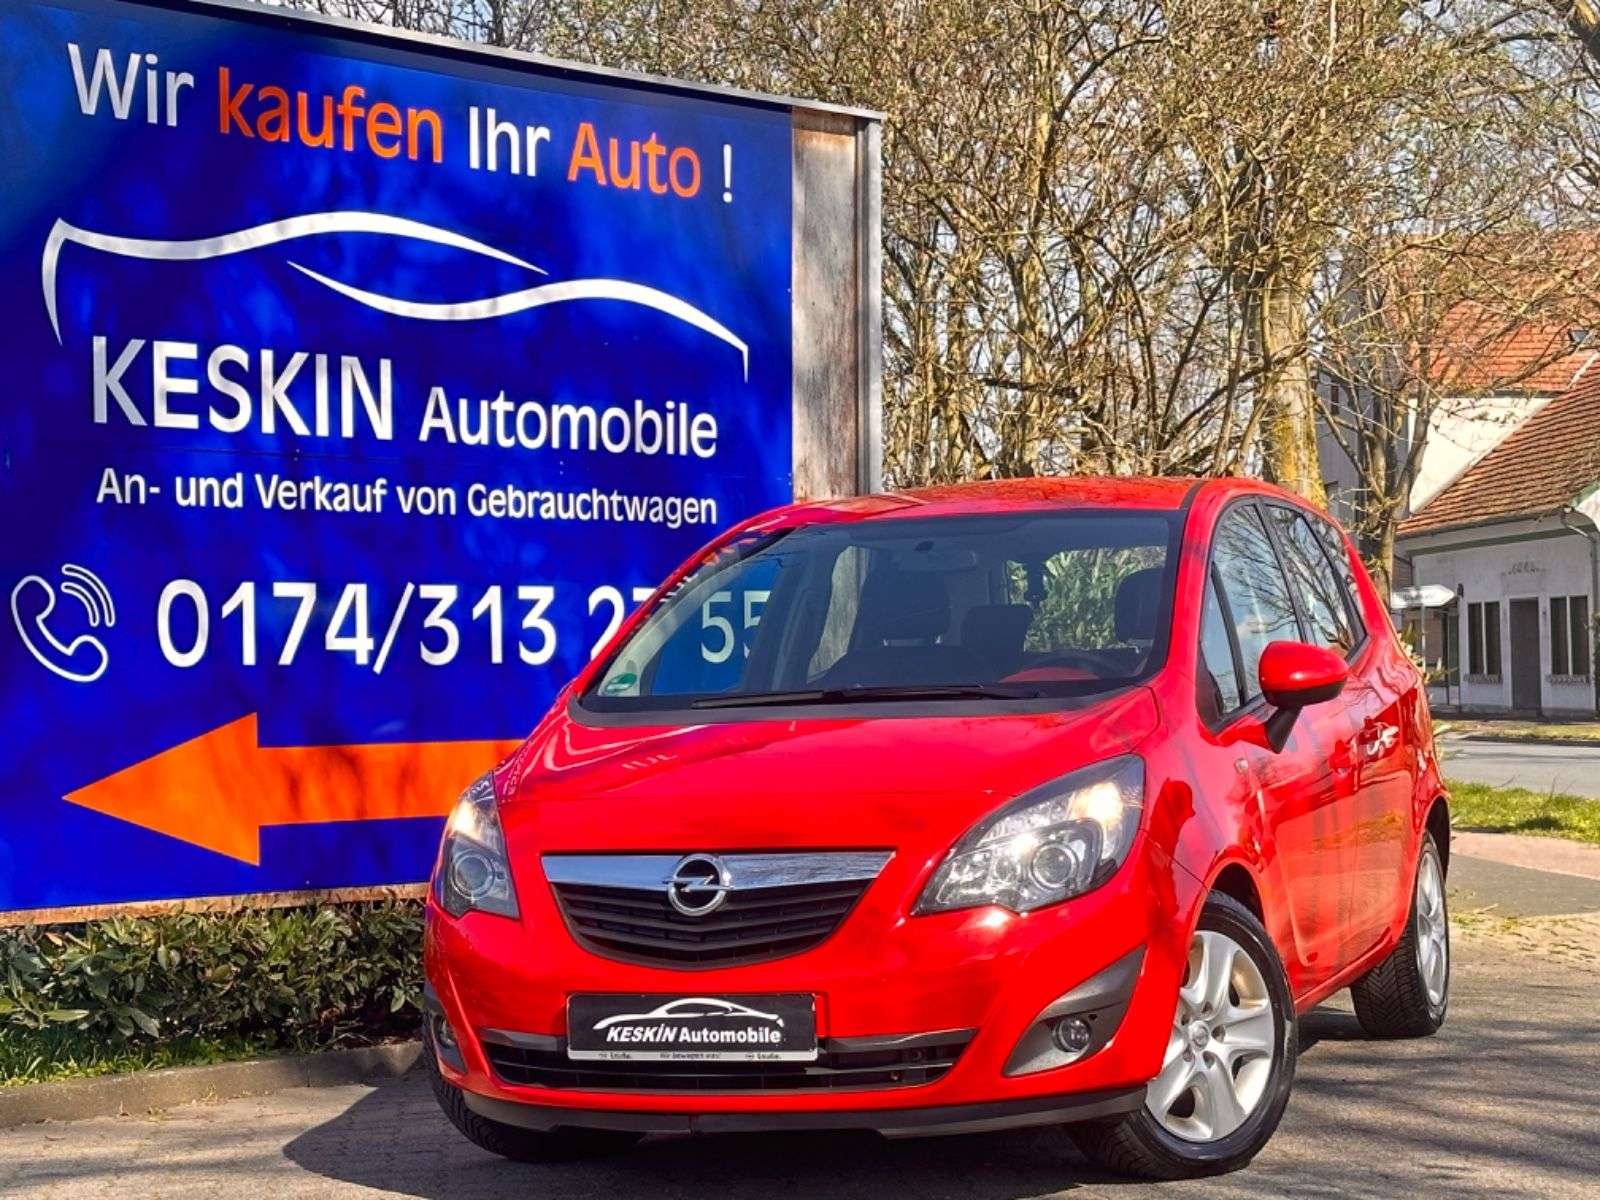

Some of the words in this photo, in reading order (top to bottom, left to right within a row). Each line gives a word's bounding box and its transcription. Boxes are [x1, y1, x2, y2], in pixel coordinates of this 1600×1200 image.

[68, 43, 194, 127] Wir
[219, 67, 443, 164] kaufen
[468, 105, 551, 177] Ihr
[567, 122, 702, 198] Auto
[722, 143, 734, 203] !
[93, 335, 393, 441] KESKIN
[419, 386, 718, 458] Automobile
[97, 467, 160, 505] An-
[176, 472, 244, 508] und
[255, 473, 388, 514] Verkauf
[396, 485, 457, 516] von
[467, 483, 718, 529] Gebrauchtwagen
[158, 578, 557, 675] 0174/313
[678, 1027, 782, 1043] Automobile
